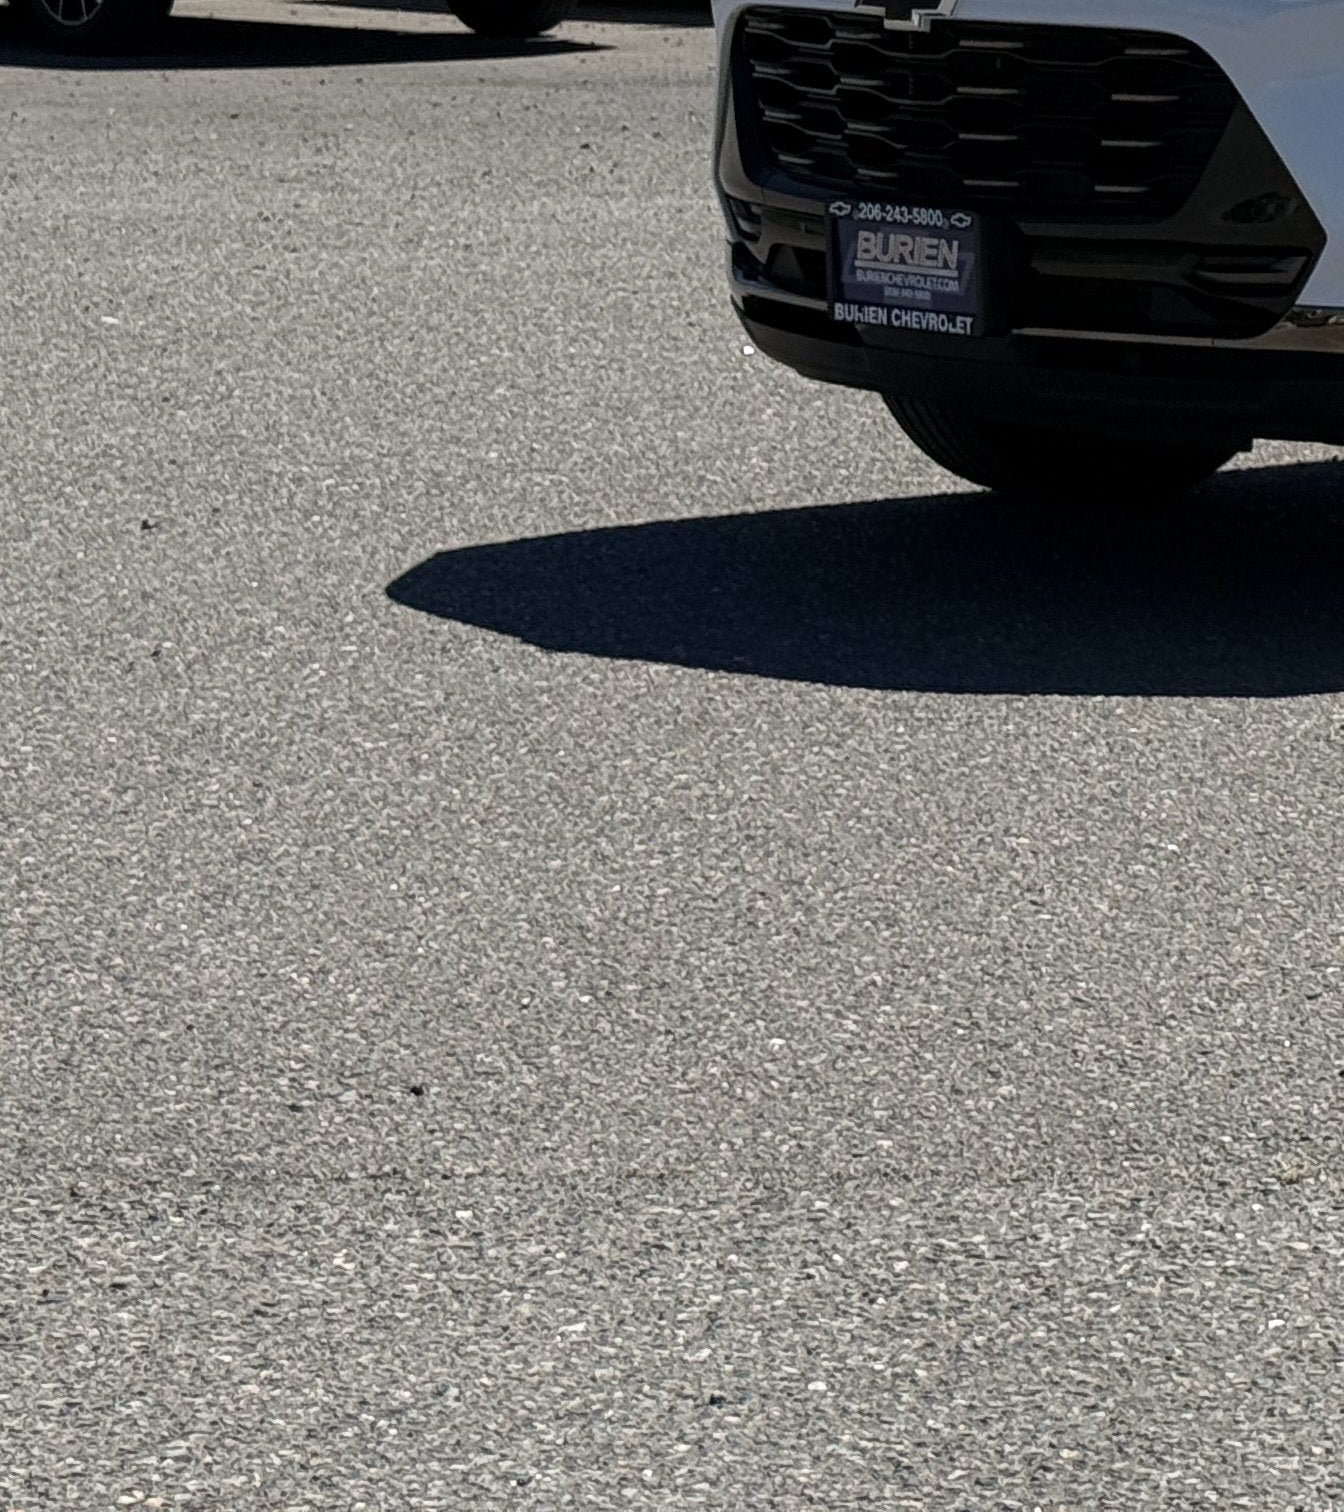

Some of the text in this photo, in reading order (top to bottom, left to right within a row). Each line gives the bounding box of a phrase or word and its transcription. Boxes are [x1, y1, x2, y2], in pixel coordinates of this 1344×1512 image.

[859, 202, 943, 227] 206-243-5800
[857, 230, 959, 269] BURIEN
[834, 302, 973, 335] BURIEN CHEVROLET
